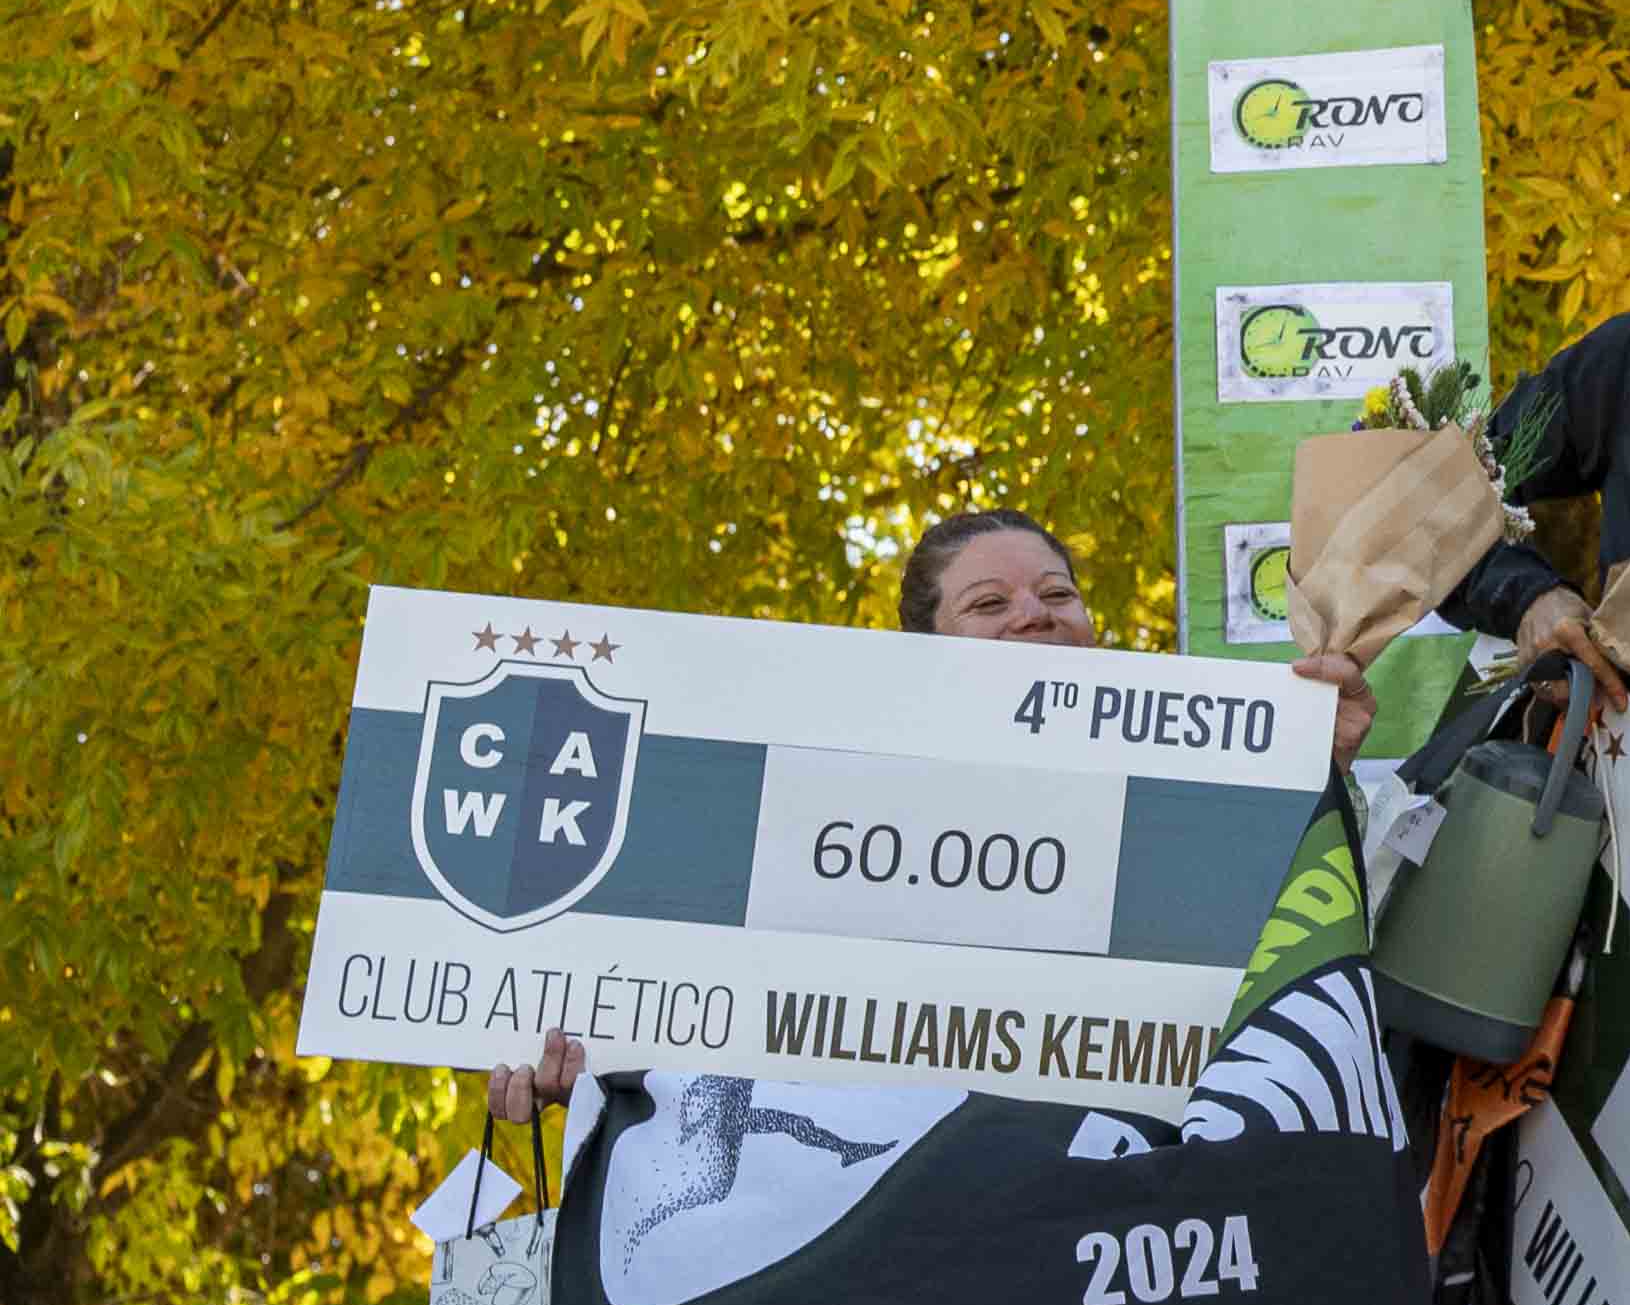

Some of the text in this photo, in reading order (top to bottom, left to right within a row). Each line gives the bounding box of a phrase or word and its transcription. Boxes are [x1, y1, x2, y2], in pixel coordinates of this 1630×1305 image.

[458, 722, 599, 780] C A
[1089, 684, 1276, 754] PUESTO
[443, 789, 588, 847] W K
[812, 820, 1068, 897] 60.000
[337, 952, 470, 1027] CLUB
[484, 963, 733, 1051] ATLÉTICO
[765, 989, 1024, 1076] WILLIAMS
